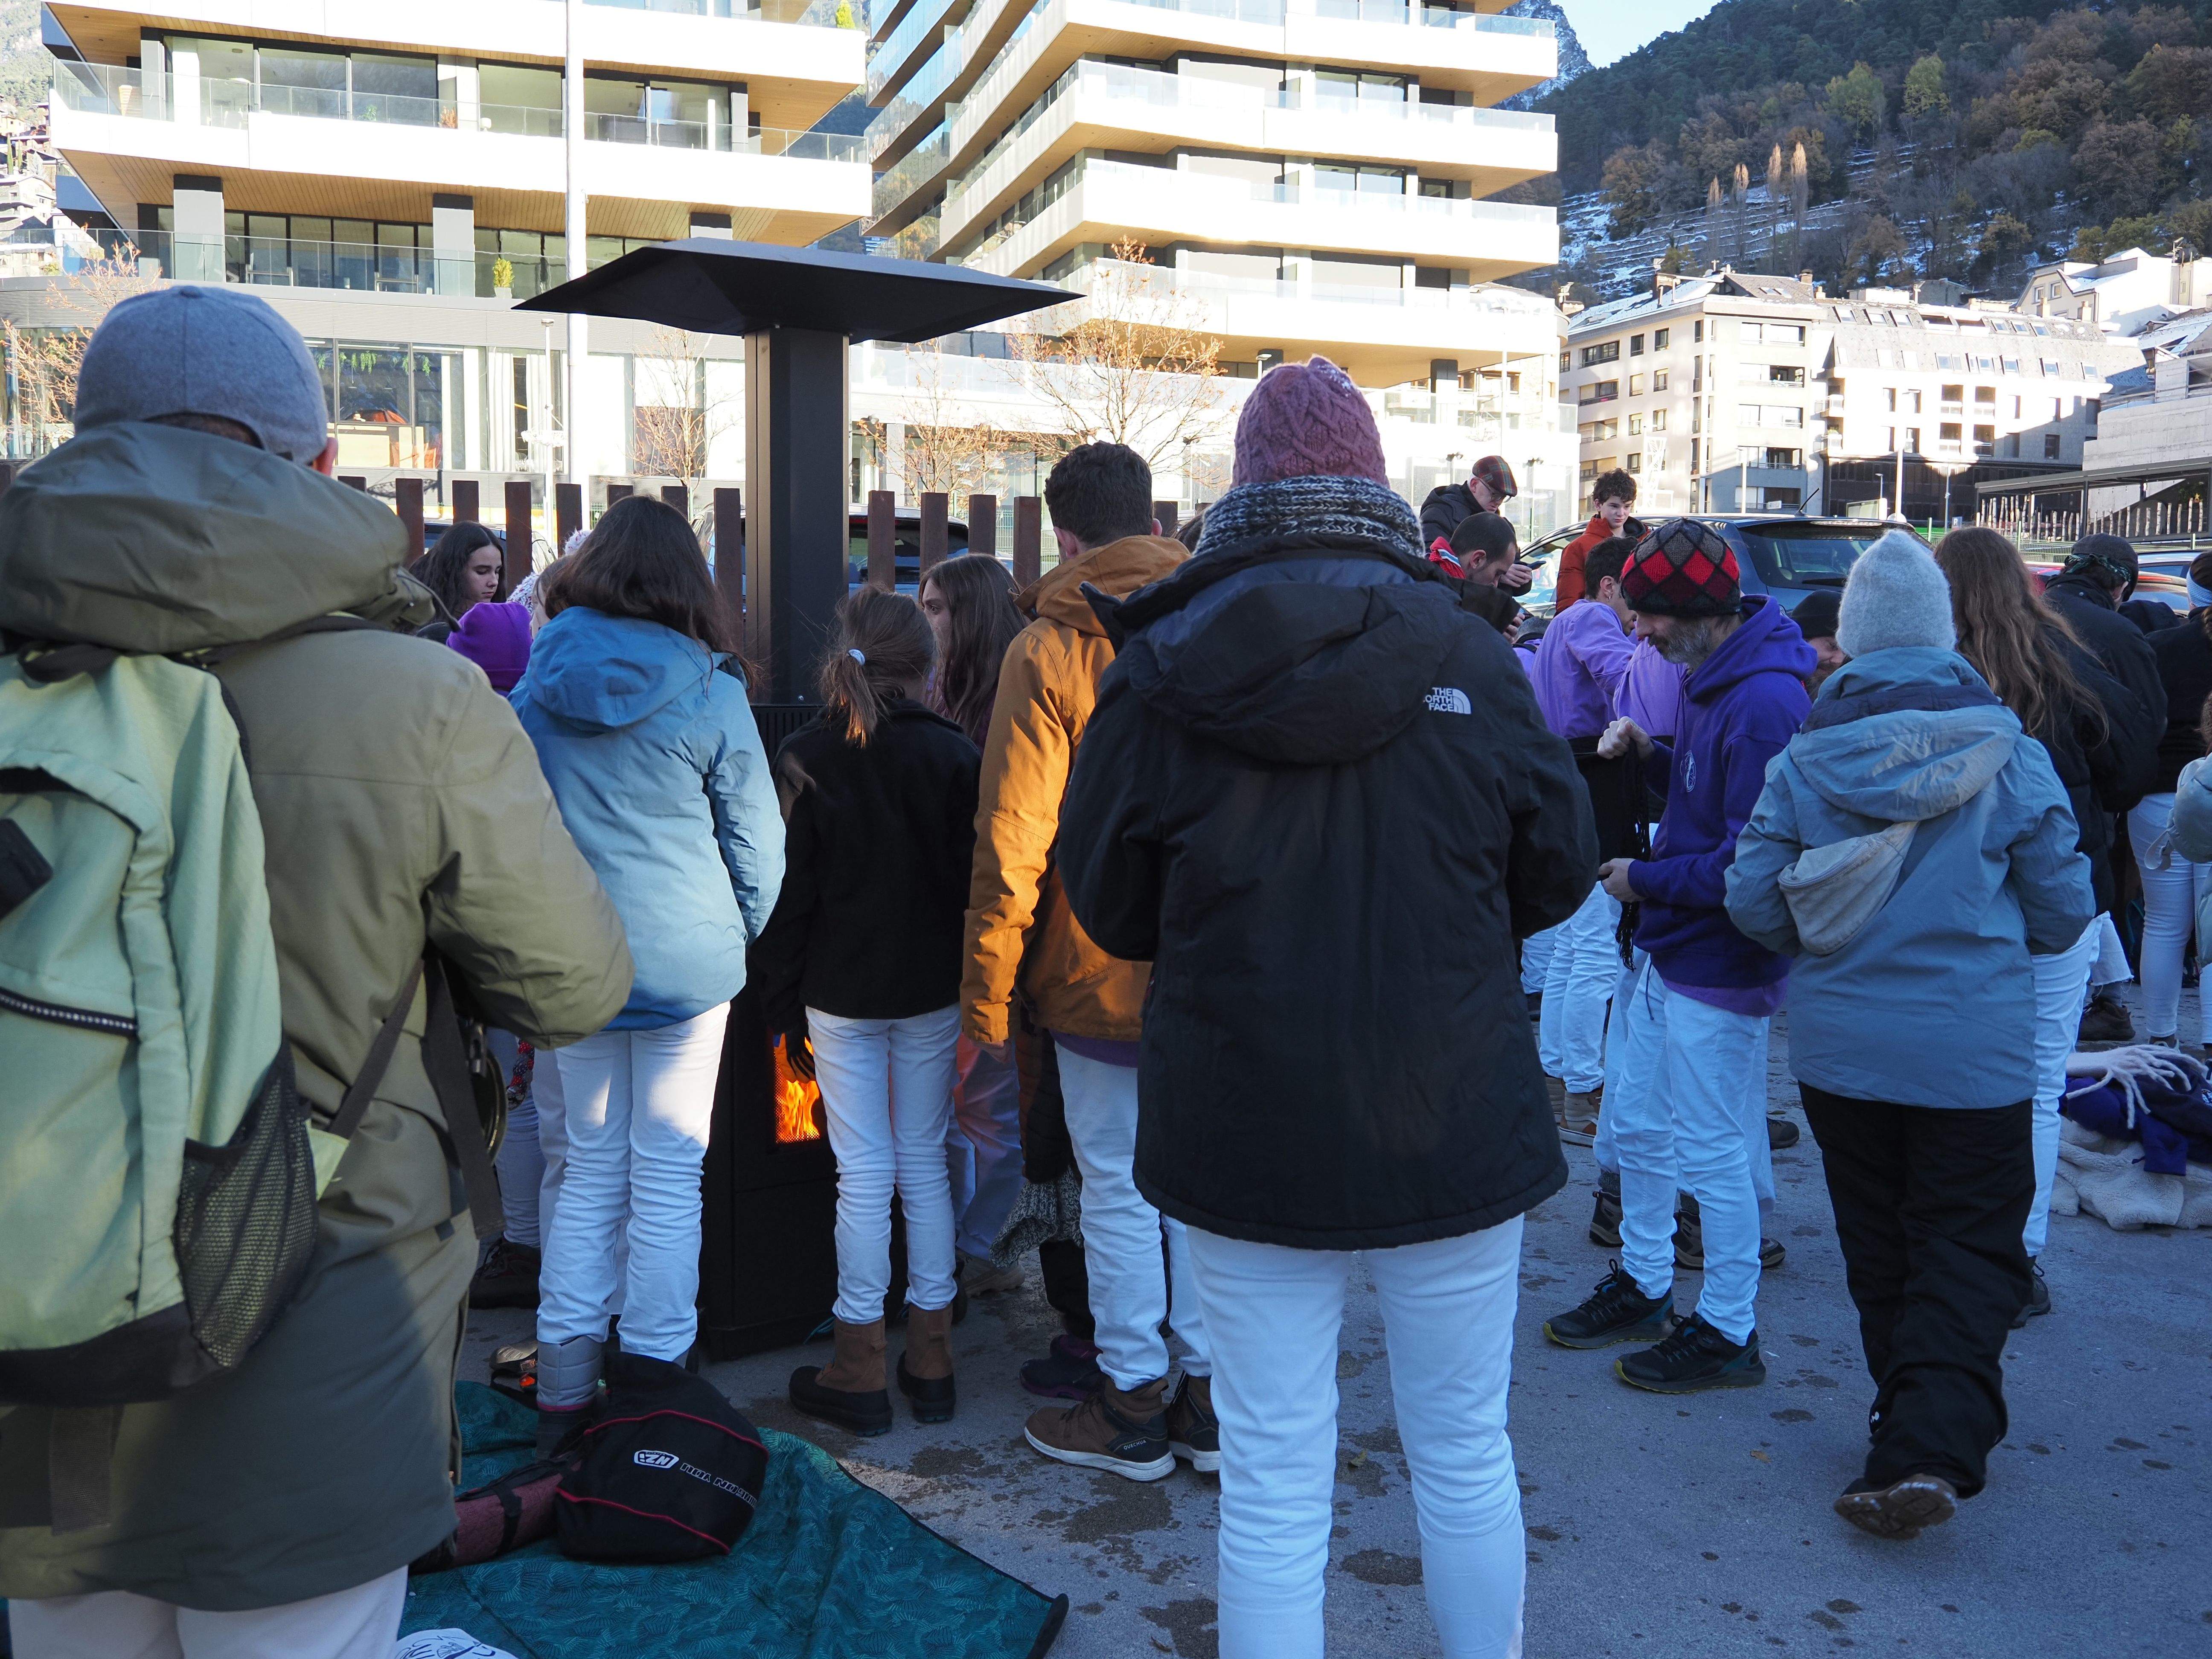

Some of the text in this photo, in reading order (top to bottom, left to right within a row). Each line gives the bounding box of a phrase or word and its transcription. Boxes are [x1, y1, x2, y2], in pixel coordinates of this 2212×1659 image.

[1432, 687, 1452, 696] THE
[1423, 695, 1452, 704] ORTH
[1429, 703, 1454, 712] FACE
[1123, 1440, 1147, 1450] QUECHUA
[680, 1463, 711, 1482] YOU
